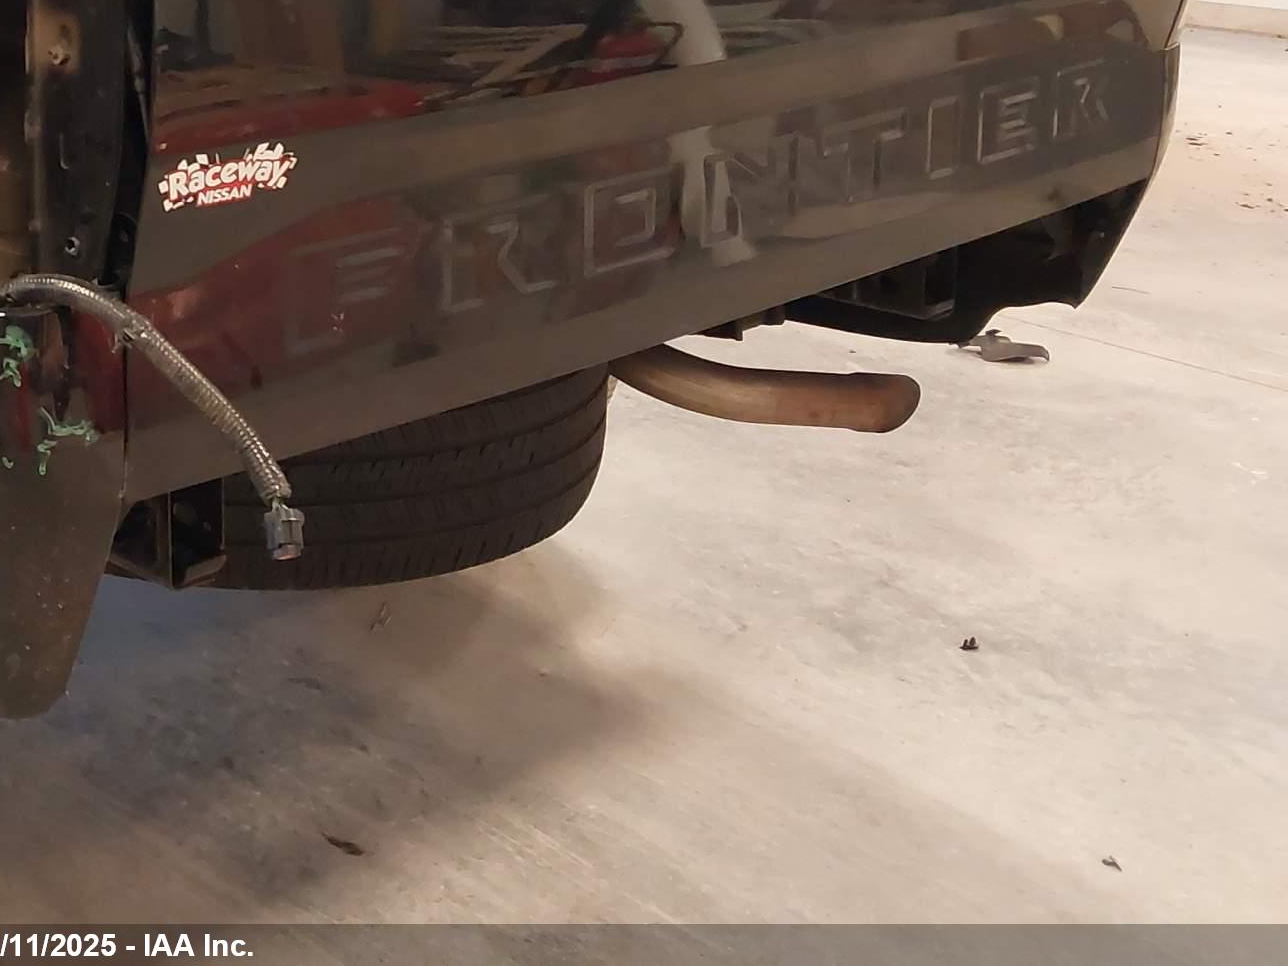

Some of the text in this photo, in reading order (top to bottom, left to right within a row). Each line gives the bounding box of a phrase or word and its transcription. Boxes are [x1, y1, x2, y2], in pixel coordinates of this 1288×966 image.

[168, 159, 291, 201] Raceway
[196, 184, 253, 206] NISSAN
[286, 58, 1111, 356] FRONTIER
